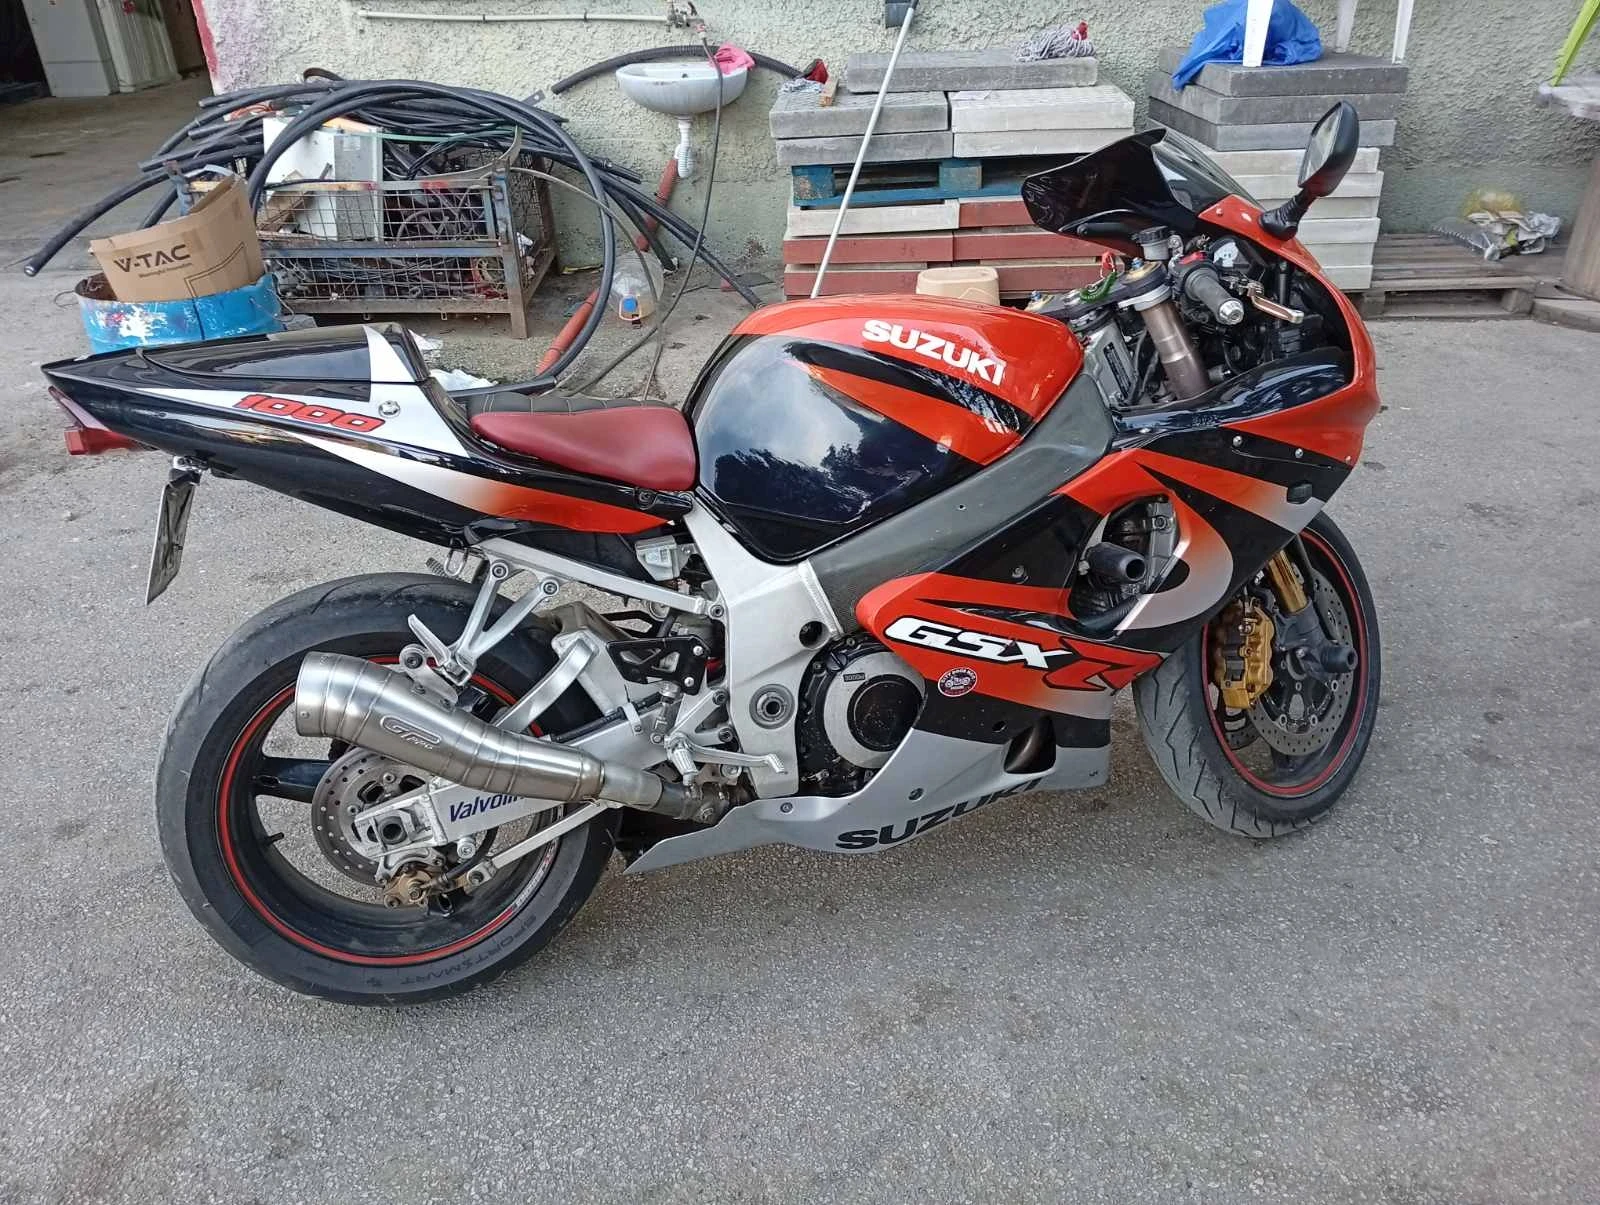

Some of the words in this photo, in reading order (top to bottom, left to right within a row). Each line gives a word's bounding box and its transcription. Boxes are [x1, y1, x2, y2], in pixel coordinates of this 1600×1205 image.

[113, 244, 191, 273] V-TAC
[861, 319, 1007, 386] SUZUKI
[232, 393, 386, 433] 1000
